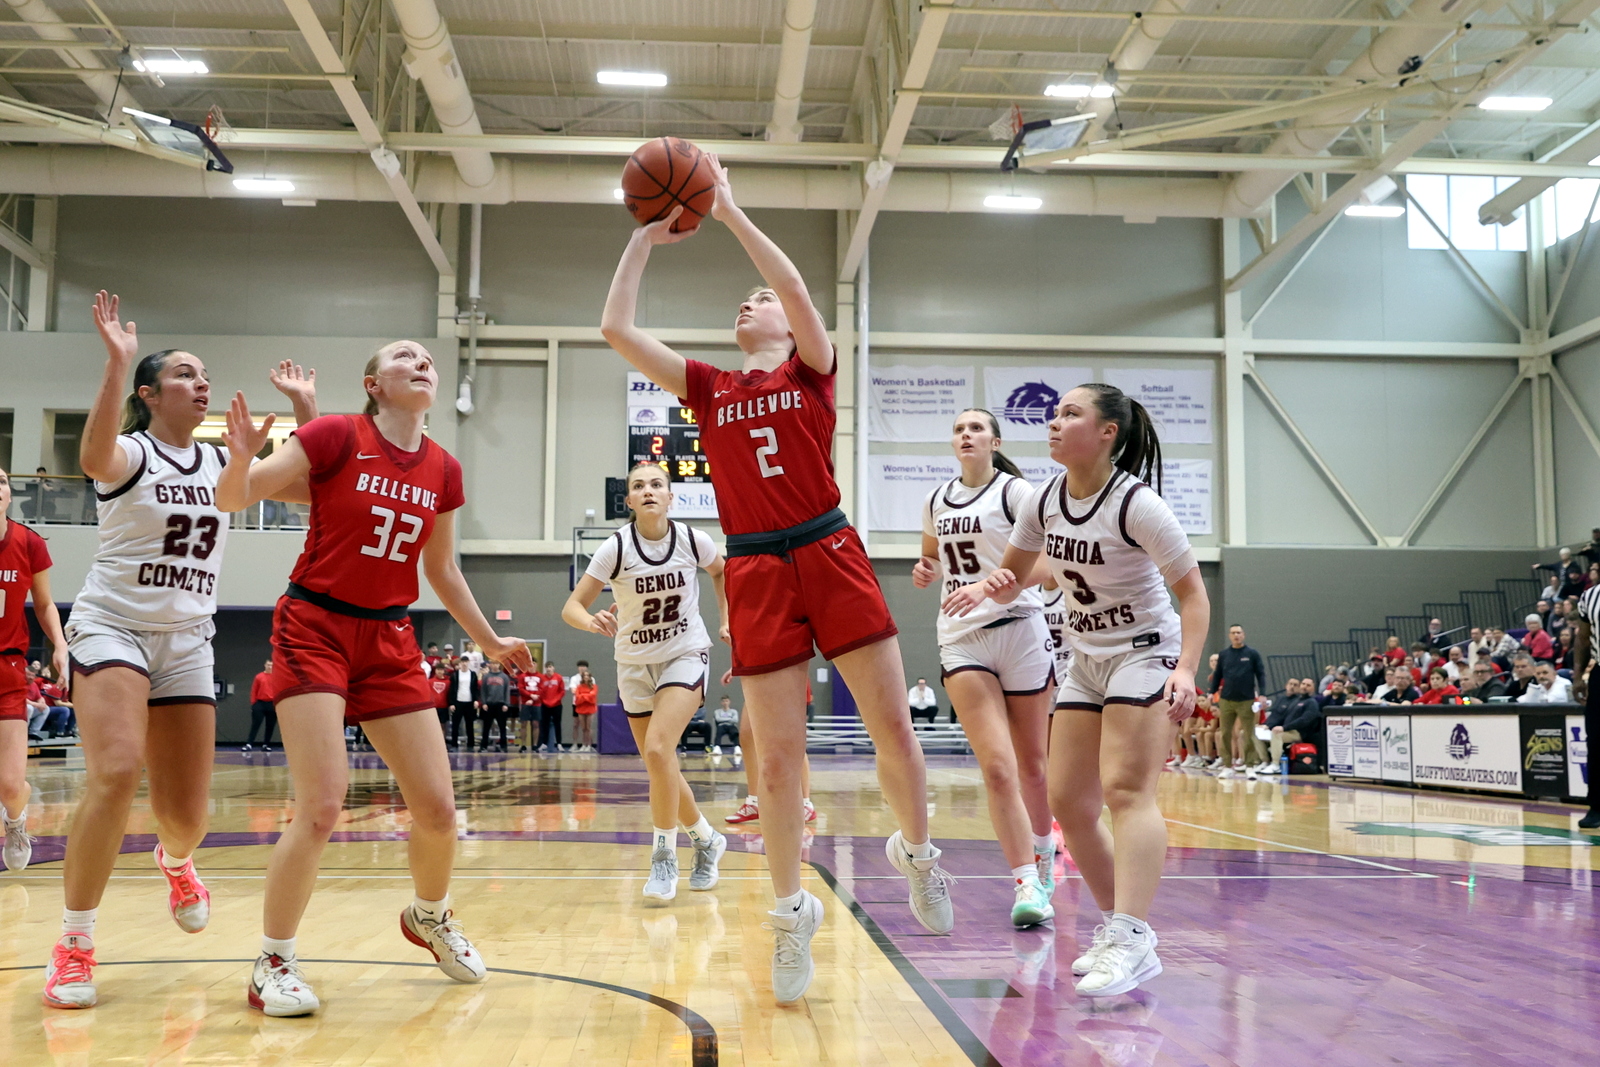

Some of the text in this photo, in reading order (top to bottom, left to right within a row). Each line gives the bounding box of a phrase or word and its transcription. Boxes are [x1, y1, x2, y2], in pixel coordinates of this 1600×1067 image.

[872, 378, 966, 387] Women's Basketball
[717, 391, 802, 427] BELLEVUE
[631, 427, 670, 435] BLUFFTON
[652, 437, 663, 454] 2
[749, 426, 784, 478] 2
[679, 461, 697, 476] 32
[883, 465, 954, 473] Women's Tennis
[1020, 466, 1046, 474] men's
[155, 484, 216, 506] GENO
[356, 473, 438, 511] BELLEVUE
[163, 514, 219, 560] 23
[360, 505, 424, 563] 32
[937, 516, 983, 536] GENOA
[943, 541, 981, 575] 15
[1046, 534, 1105, 565] GENOA
[0, 570, 18, 582] UE
[138, 563, 215, 596] COMETS
[635, 571, 686, 594] GENOA
[1063, 569, 1097, 606] 3
[642, 594, 681, 625] 22
[1044, 613, 1064, 625] NOA
[630, 618, 688, 644] COMETS
[700, 653, 708, 665] G
[1354, 728, 1379, 740] STOLLY
[1415, 765, 1518, 786] BLUFFTONBEAVERS.COM
